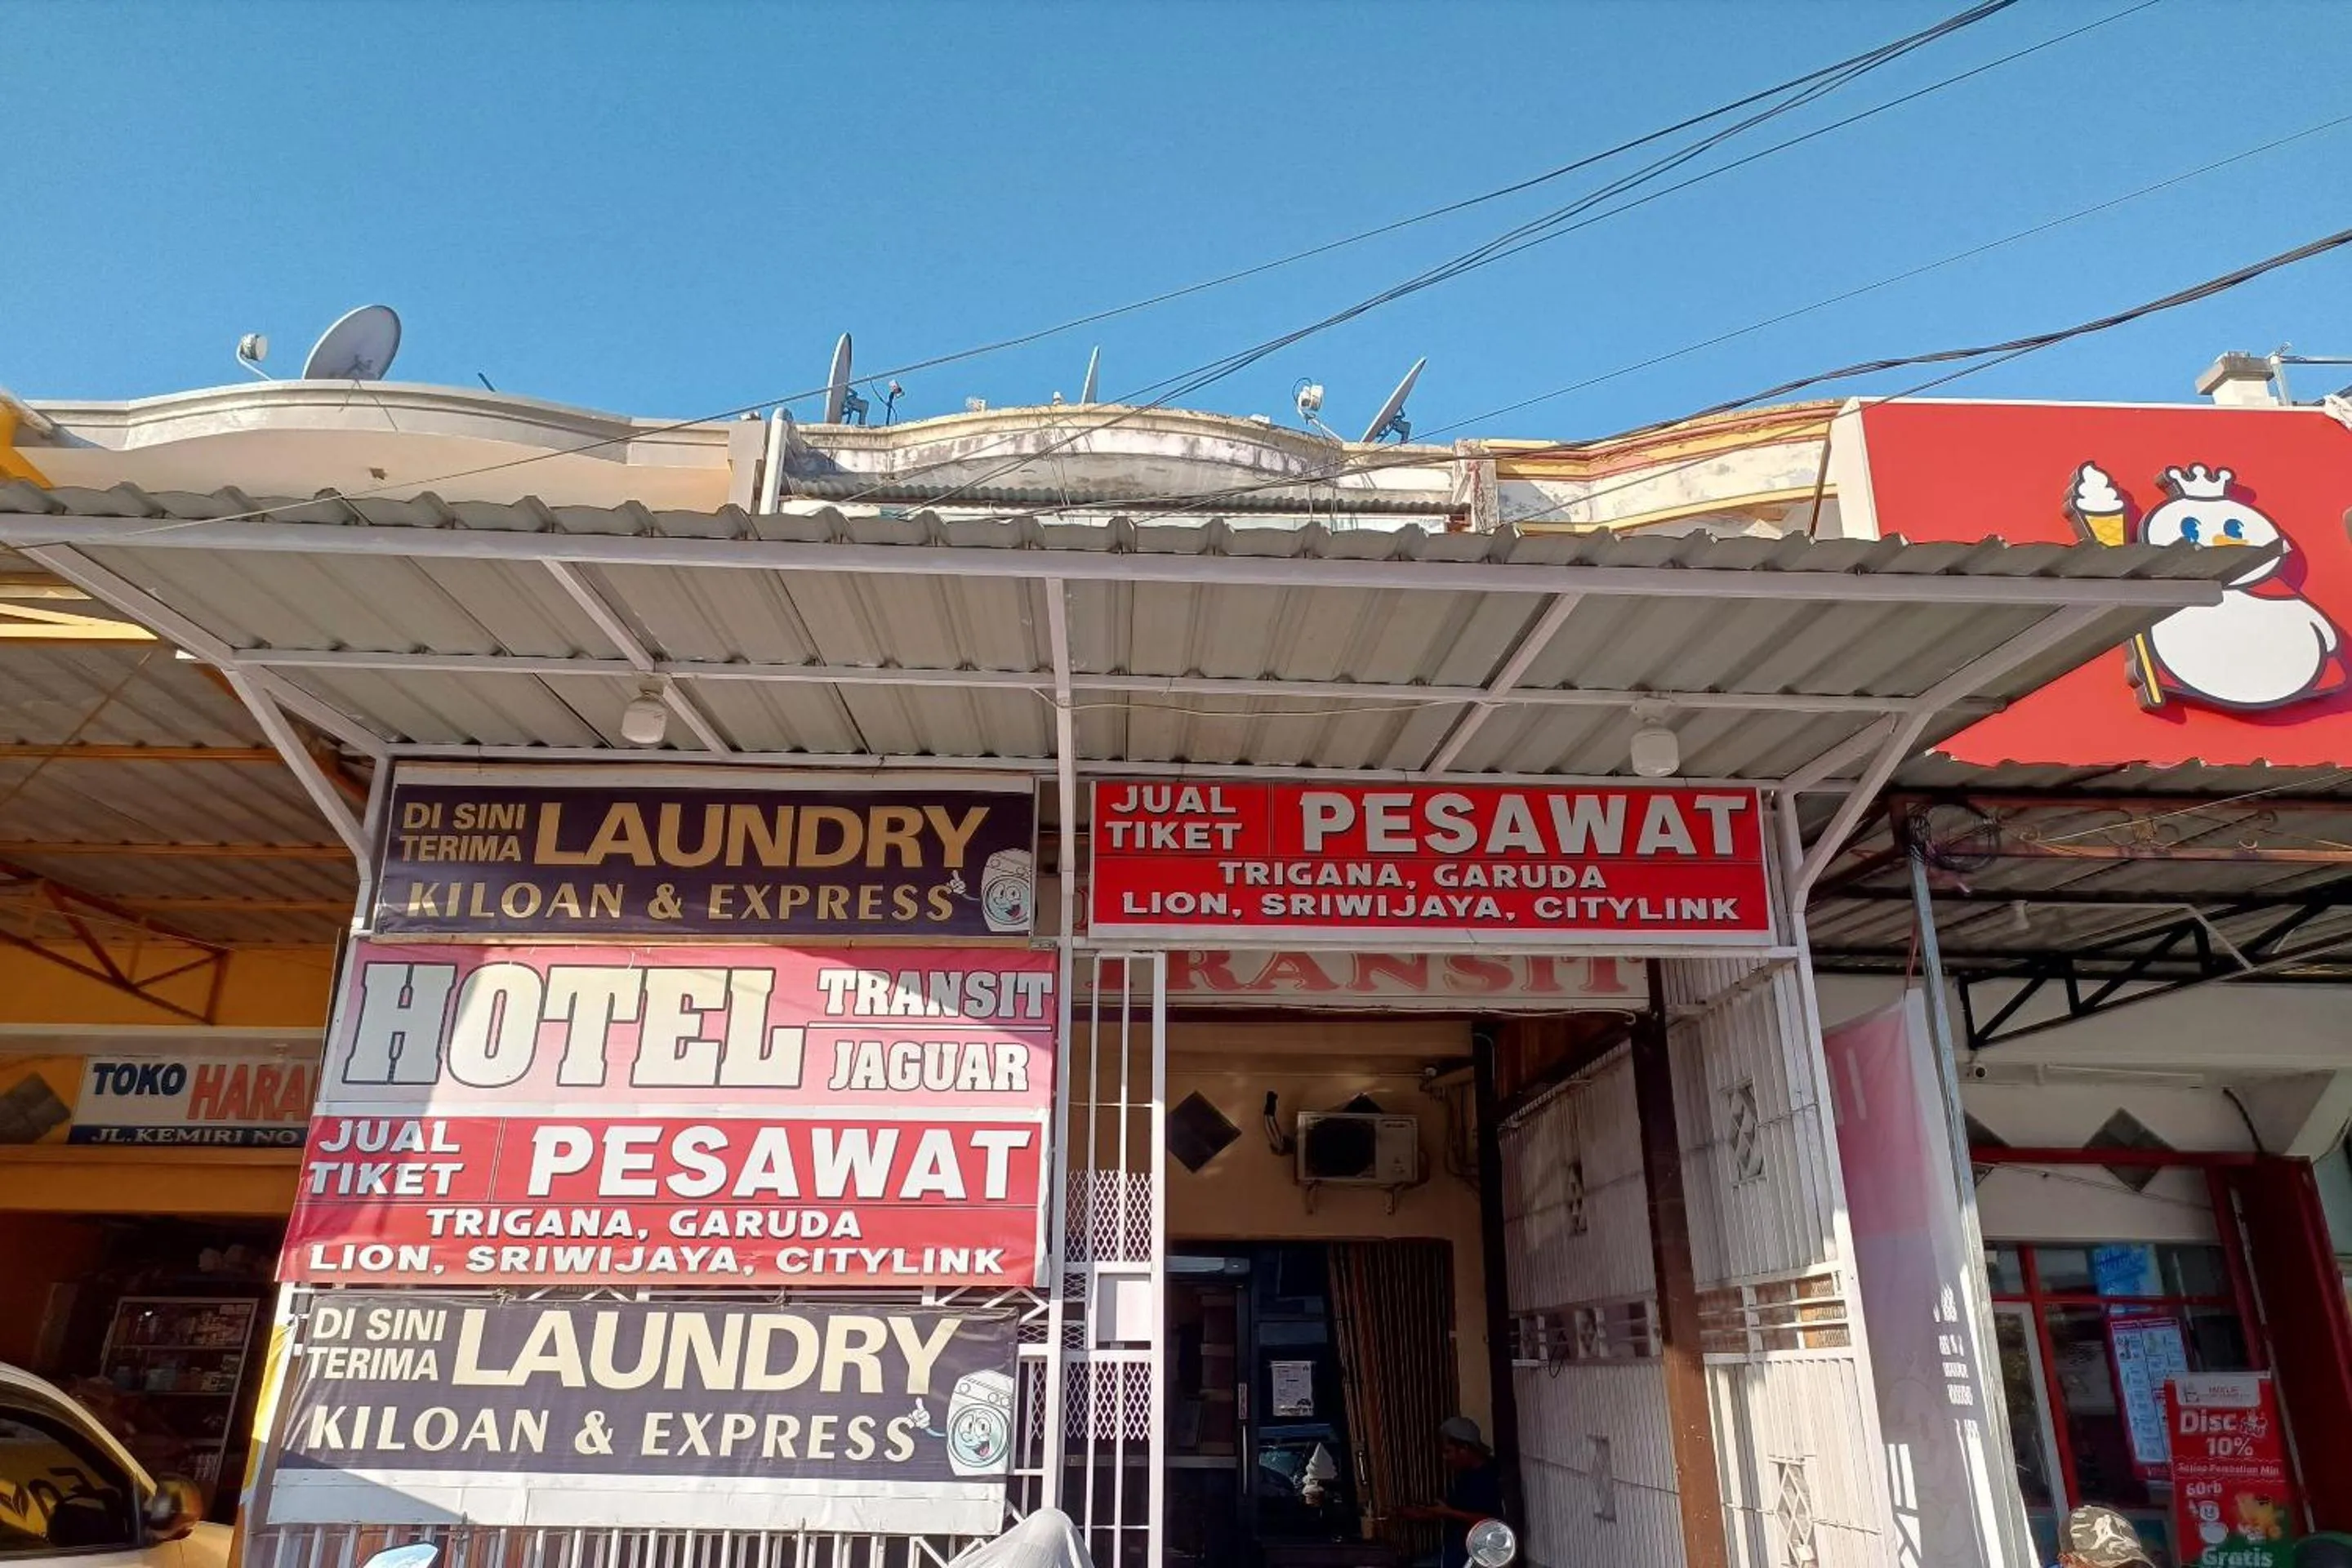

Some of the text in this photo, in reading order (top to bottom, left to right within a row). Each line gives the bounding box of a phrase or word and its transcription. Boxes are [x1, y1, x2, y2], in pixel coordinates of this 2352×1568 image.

[1111, 785, 1236, 814] JUAL
[403, 803, 525, 831] DI SINI
[1298, 792, 1748, 855] PESAWAT
[401, 835, 520, 862] TERIMA
[535, 803, 990, 868] LAUNDRY
[1105, 821, 1242, 849] TIKET
[1218, 861, 1607, 890] TRIGANA, GARUDA
[407, 883, 955, 920] KILOAN & EXPRESS
[1123, 892, 1740, 921] LION, SRIWIJAYA, CITYLINK
[817, 969, 1053, 1018] TRANSIT
[342, 961, 804, 1089] HOTEL
[828, 1041, 1028, 1092] JAGUAR
[94, 1063, 318, 1120] TOKO HARA
[318, 1120, 461, 1152] JUAL
[308, 1162, 463, 1196] TIKET
[528, 1125, 1031, 1200] PESAWAT
[426, 1209, 861, 1241] TRIGANA, GARUDA
[309, 1245, 1004, 1276] LION, SRIWIJAYA, CITYLINK
[312, 1307, 446, 1342] DI SINI
[306, 1347, 438, 1380] TERIMA
[452, 1310, 961, 1394] LAUNDRY
[307, 1405, 916, 1461] KILOAN & EXPRESS
[2180, 1410, 2237, 1433] Disc
[2206, 1437, 2254, 1456] 10%
[2201, 1546, 2274, 1566] Gratis
